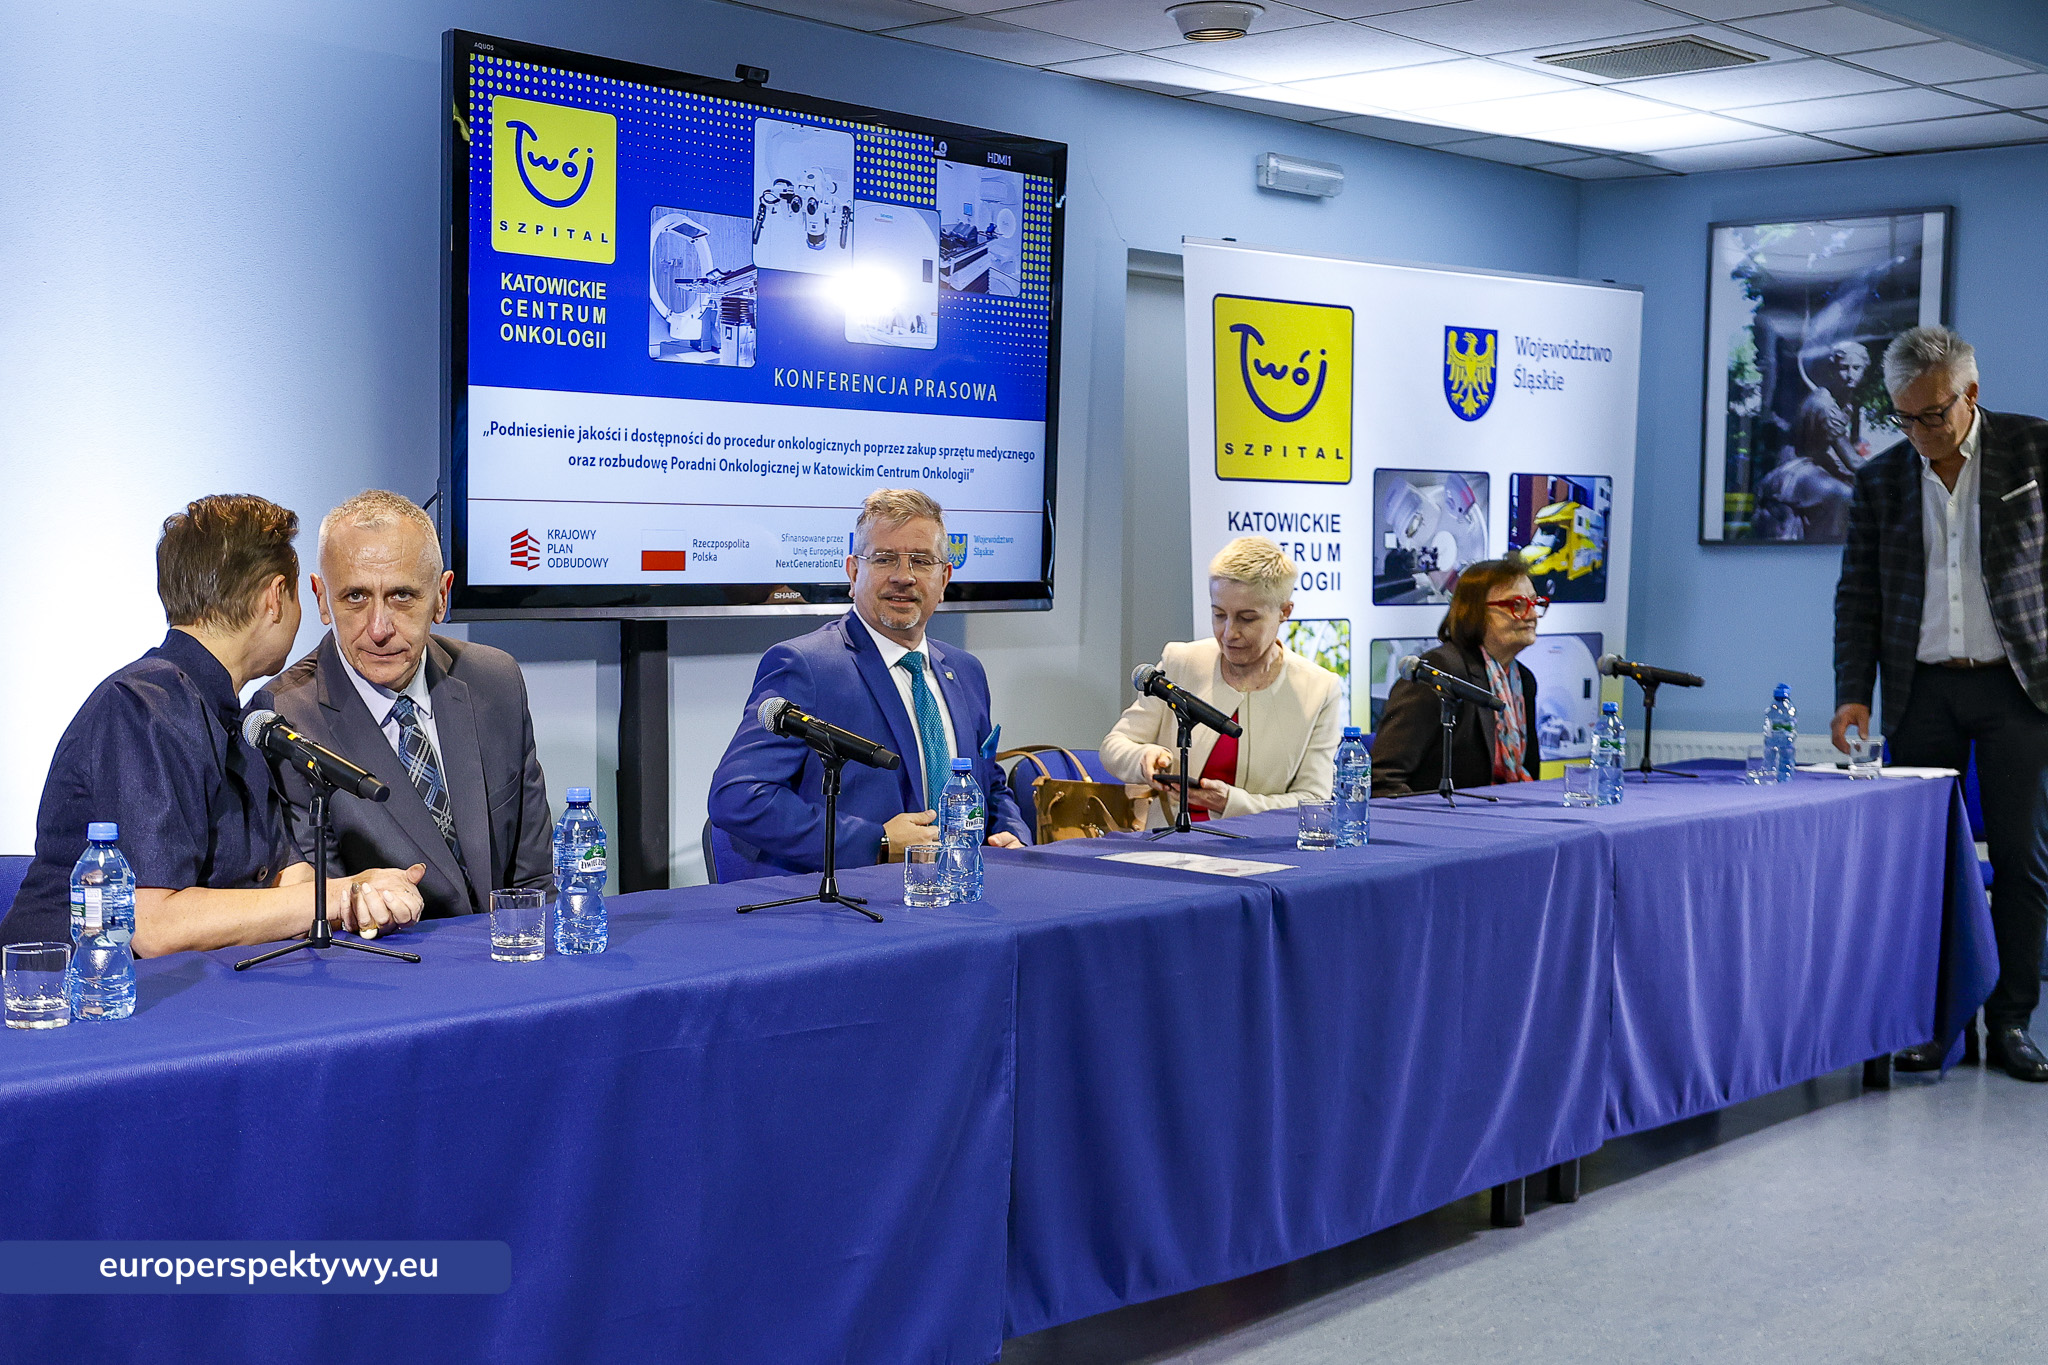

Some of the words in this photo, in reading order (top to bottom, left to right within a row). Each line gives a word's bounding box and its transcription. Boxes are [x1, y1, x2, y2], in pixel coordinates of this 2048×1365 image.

[474, 42, 494, 50] AQUOS
[506, 120, 594, 208] Twój
[987, 152, 1012, 166] HDMI1
[499, 220, 609, 244] SZPITAL
[500, 272, 607, 300] KATOWICKIE
[500, 297, 607, 325] CENTRUM
[500, 323, 607, 349] ONKOLOGII
[1514, 335, 1613, 363] Województwo
[1229, 323, 1328, 423] Twój
[1513, 363, 1565, 395] Śląskie
[774, 367, 909, 396] KONFERENCJA
[914, 378, 998, 402] PRASOWA
[577, 425, 621, 443] jakości
[624, 428, 628, 441] i
[631, 428, 704, 448] dostępności
[706, 432, 721, 446] do
[724, 434, 776, 450] procedur
[777, 436, 861, 456] onkologicznych
[863, 443, 905, 457] poprzez
[906, 442, 937, 459] zakup
[938, 446, 975, 461] sprzętu
[976, 446, 1036, 463] medycznego
[1224, 442, 1345, 461] SZPITAL
[568, 455, 596, 467] oraz
[599, 453, 668, 474] rozbudowę
[671, 456, 717, 471] Poradni
[719, 458, 800, 478] Onkologicznej
[801, 464, 812, 475] w
[813, 461, 875, 477] Katowickim
[876, 464, 920, 479] Centrum
[1228, 510, 1342, 533] KATOWICKIE
[547, 529, 597, 541] KRAJOWY
[692, 538, 751, 550] Rzeczpospolita
[781, 533, 825, 543] Sfinansowane
[826, 535, 844, 544] przez
[547, 543, 574, 554] PLAN
[692, 552, 718, 562] Polska
[809, 546, 844, 557] Europejską
[1279, 542, 1341, 562] TRUM
[547, 557, 609, 569] ODBUDOWY
[775, 558, 844, 569] NextGenerationEU
